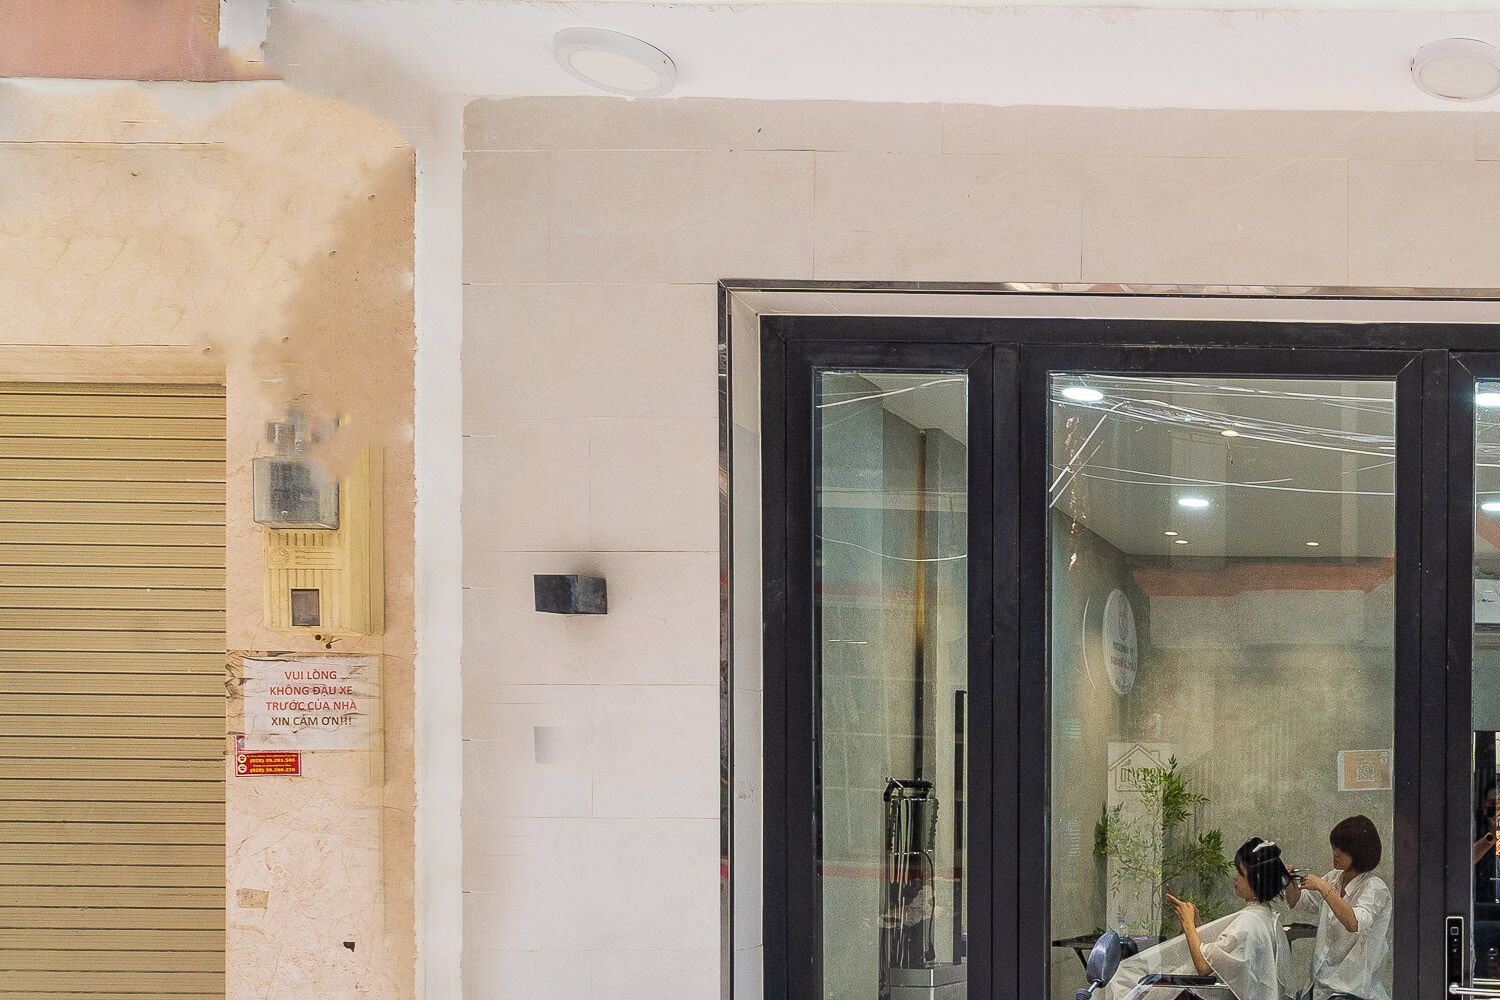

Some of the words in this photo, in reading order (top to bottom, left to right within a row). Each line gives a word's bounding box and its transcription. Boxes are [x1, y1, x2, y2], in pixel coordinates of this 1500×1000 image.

[285, 671, 304, 680] VUI
[307, 668, 337, 680] LÒNG
[269, 684, 310, 696] KHÔNG
[339, 686, 353, 695] XE
[333, 698, 358, 711] NHÀ
[271, 717, 290, 726] XIN
